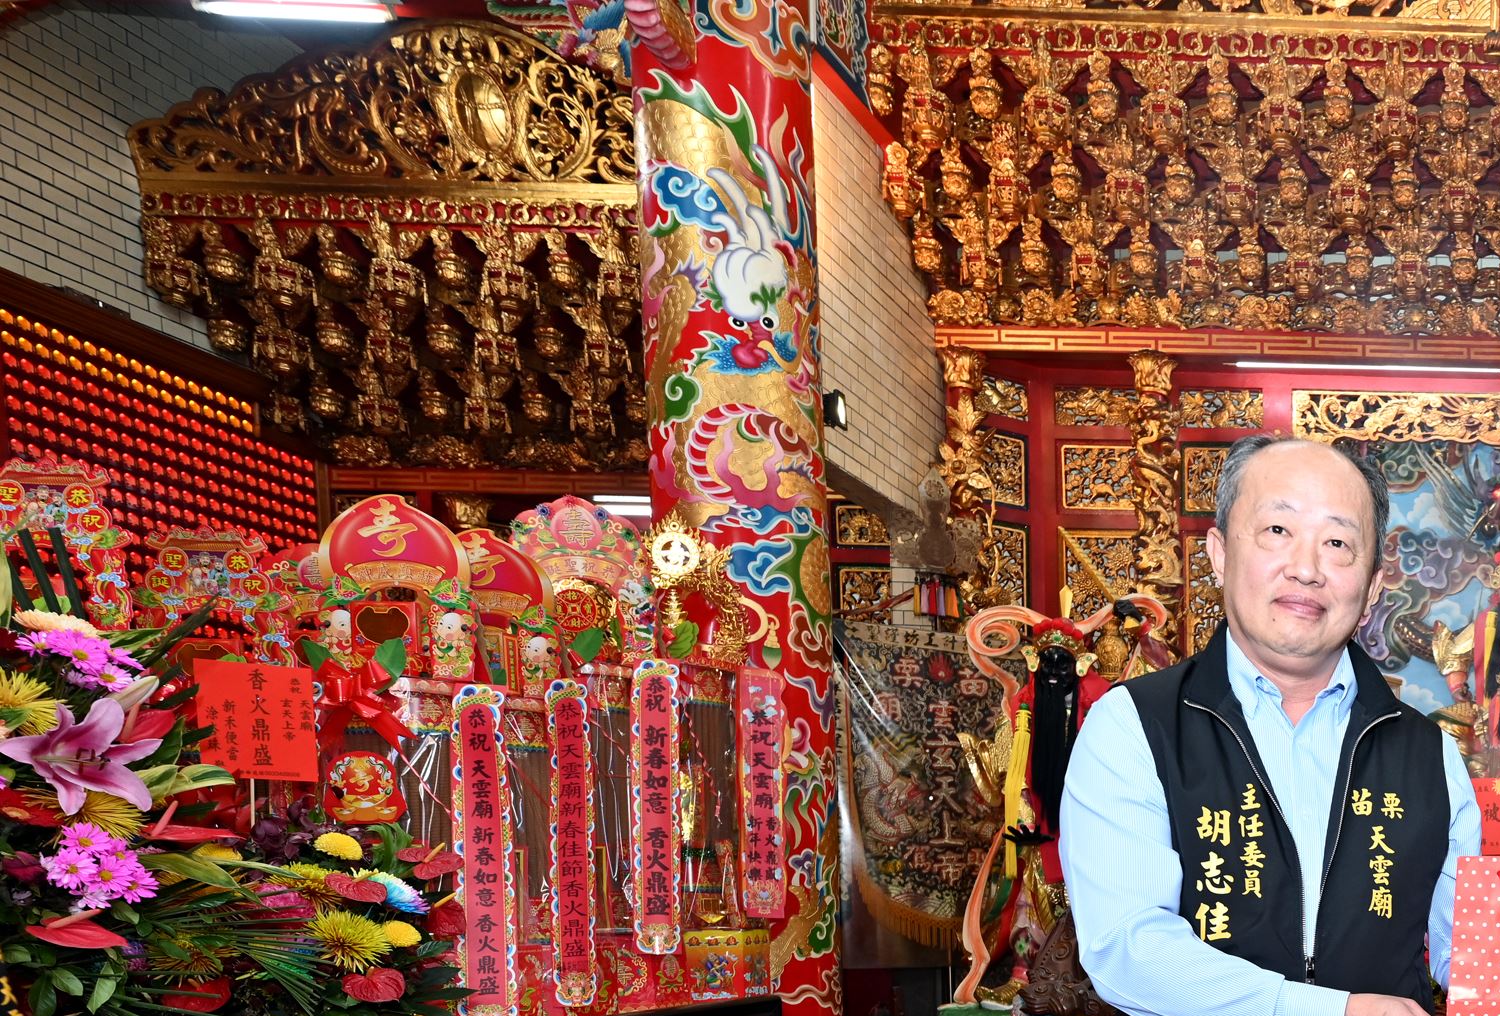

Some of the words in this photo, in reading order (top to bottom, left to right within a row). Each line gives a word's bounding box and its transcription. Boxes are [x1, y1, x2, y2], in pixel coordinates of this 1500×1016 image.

[247, 668, 273, 766] 香火鼎盛
[280, 698, 295, 742] 玄天上帝
[299, 700, 313, 732] 天雲廟
[749, 710, 776, 810] 恭祝天雲廟
[556, 702, 588, 957] 恭祝天雲廟新春佳節香火鼎盛
[1238, 783, 1266, 899] 主任委員
[1351, 788, 1405, 820] 苗栗
[1195, 805, 1235, 942] 胡志佳
[1367, 825, 1395, 919] 天雲廟
